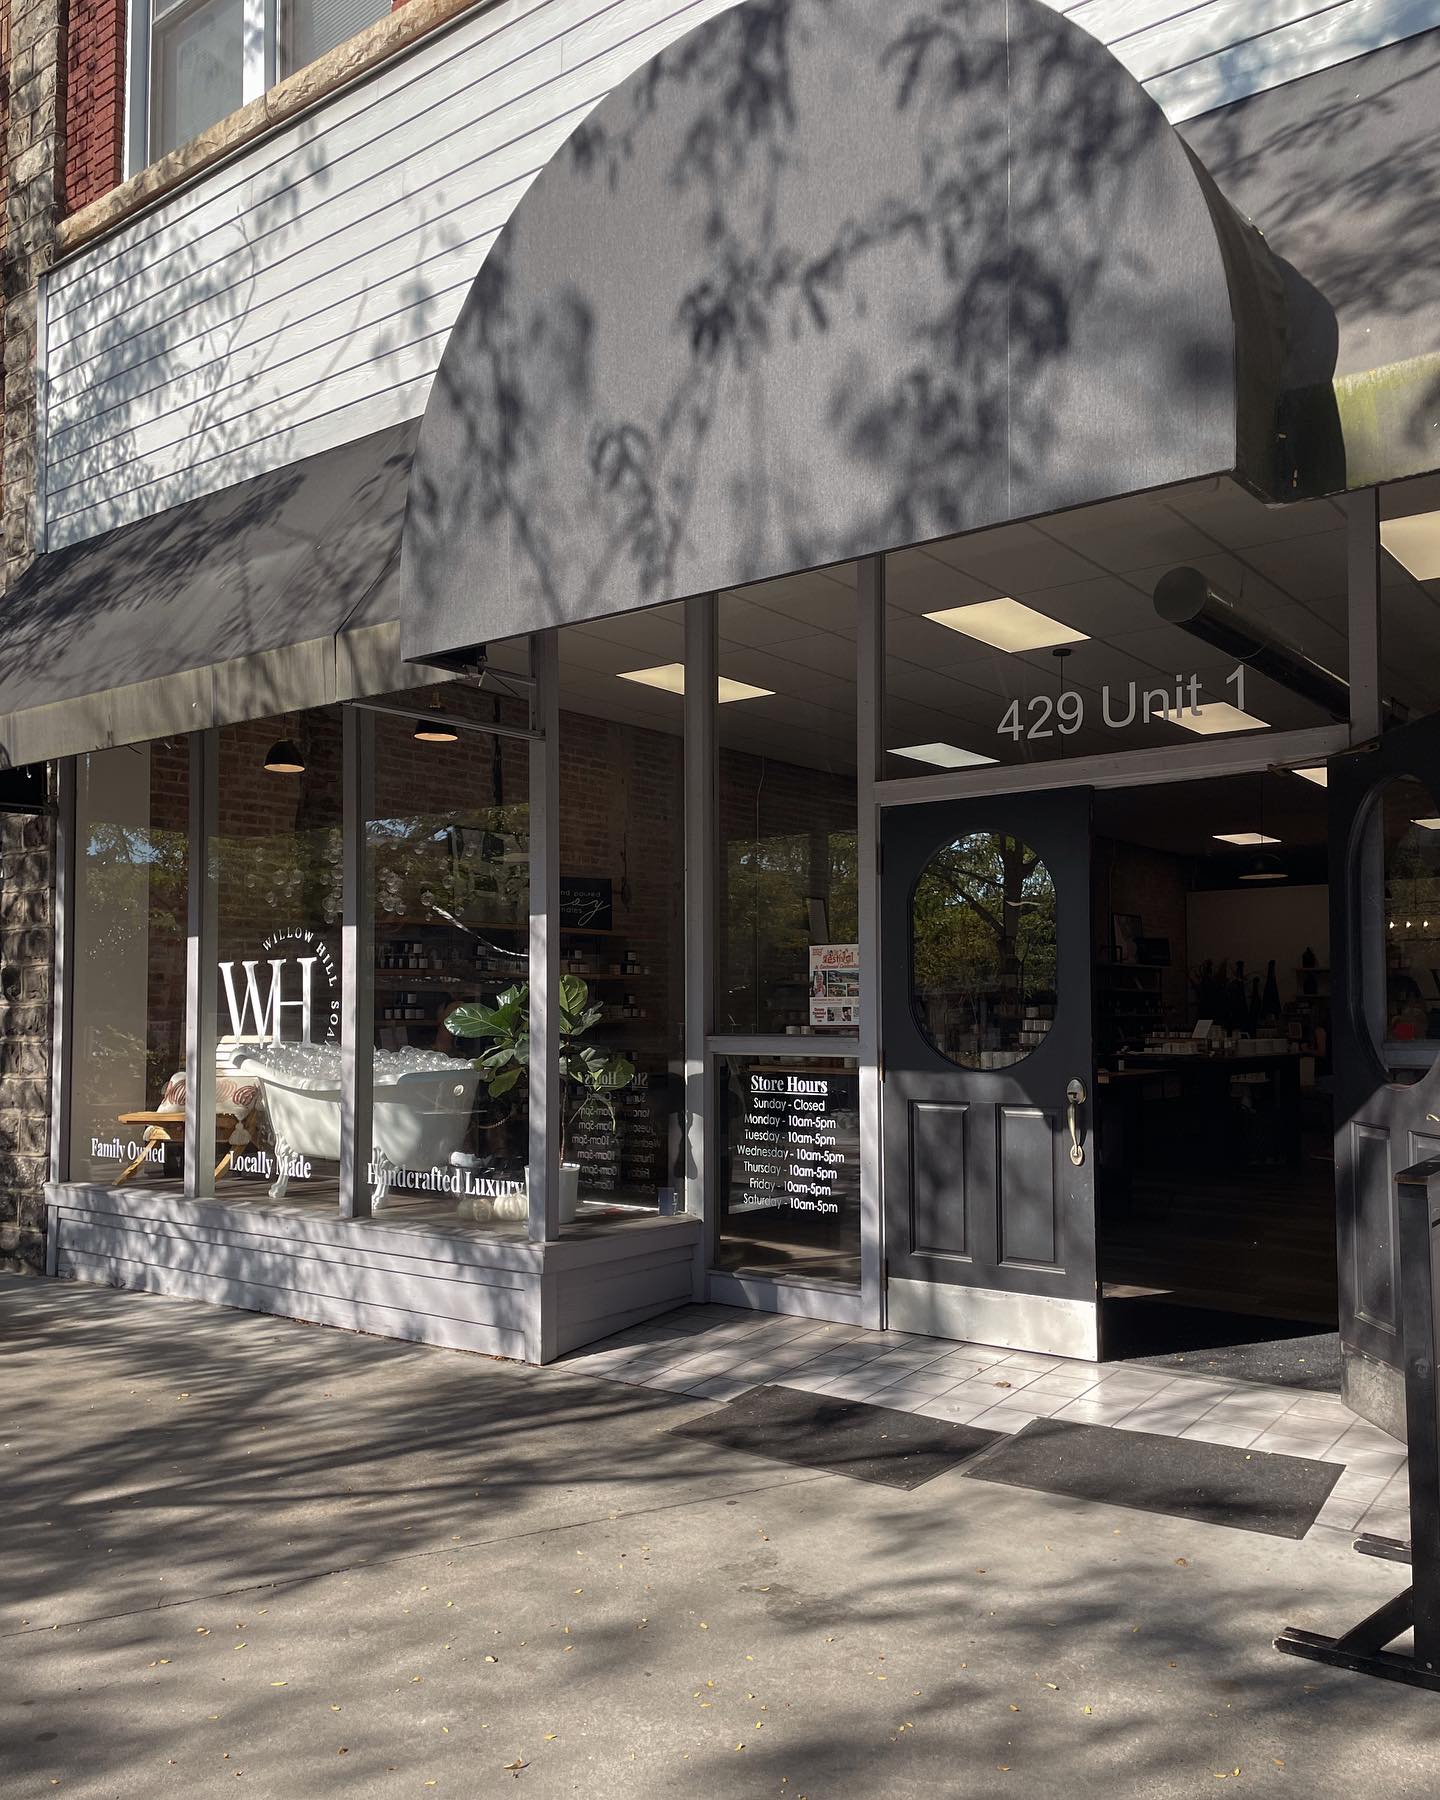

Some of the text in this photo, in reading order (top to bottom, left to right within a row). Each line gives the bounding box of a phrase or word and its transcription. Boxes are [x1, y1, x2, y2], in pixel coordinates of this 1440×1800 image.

[997, 664, 1245, 741] 429 Unit 1
[262, 927, 314, 951] WILLOW
[316, 942, 338, 987] HILL
[218, 957, 317, 1050] WH
[751, 1075, 828, 1093] Store Hours
[754, 1097, 786, 1112] Sunday
[793, 1099, 825, 1112] Closed
[744, 1113, 780, 1127] Monday
[788, 1115, 836, 1131] 10am-5pm
[744, 1129, 780, 1143] Tuesday
[787, 1132, 836, 1147] 10am-5pm
[91, 1137, 126, 1163] Family
[737, 1144, 789, 1160] Wednesday
[796, 1149, 845, 1164] 10am-5pm
[229, 1150, 274, 1179] Locally
[743, 1161, 781, 1176] Thursday
[789, 1165, 838, 1181] 10am-5pm
[367, 1162, 525, 1198] Handcrafted Luxury
[750, 1177, 775, 1192] Friday
[784, 1181, 831, 1197] 10am-5pm
[743, 1193, 782, 1209] Saturday
[789, 1197, 838, 1214] 10am-5pm
